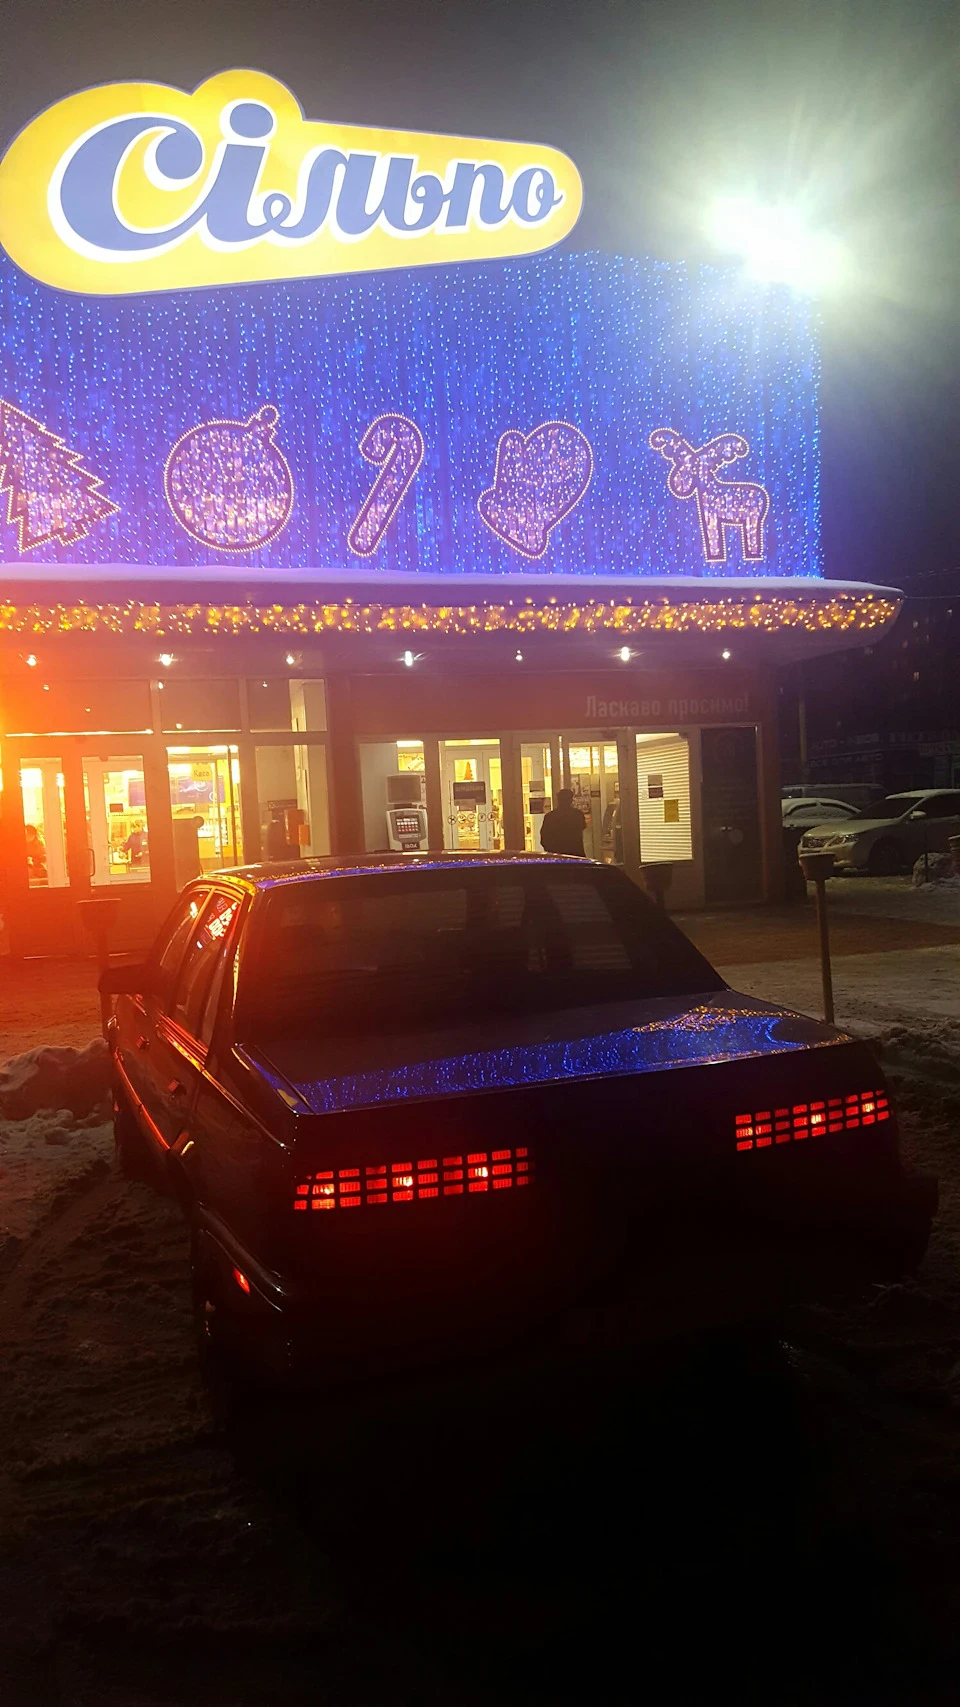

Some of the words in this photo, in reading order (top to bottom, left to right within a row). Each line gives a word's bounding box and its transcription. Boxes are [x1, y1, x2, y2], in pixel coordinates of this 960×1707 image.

[55, 101, 563, 255] Сільпо
[585, 695, 661, 718] Ласкаво
[668, 692, 749, 720] просимо!
